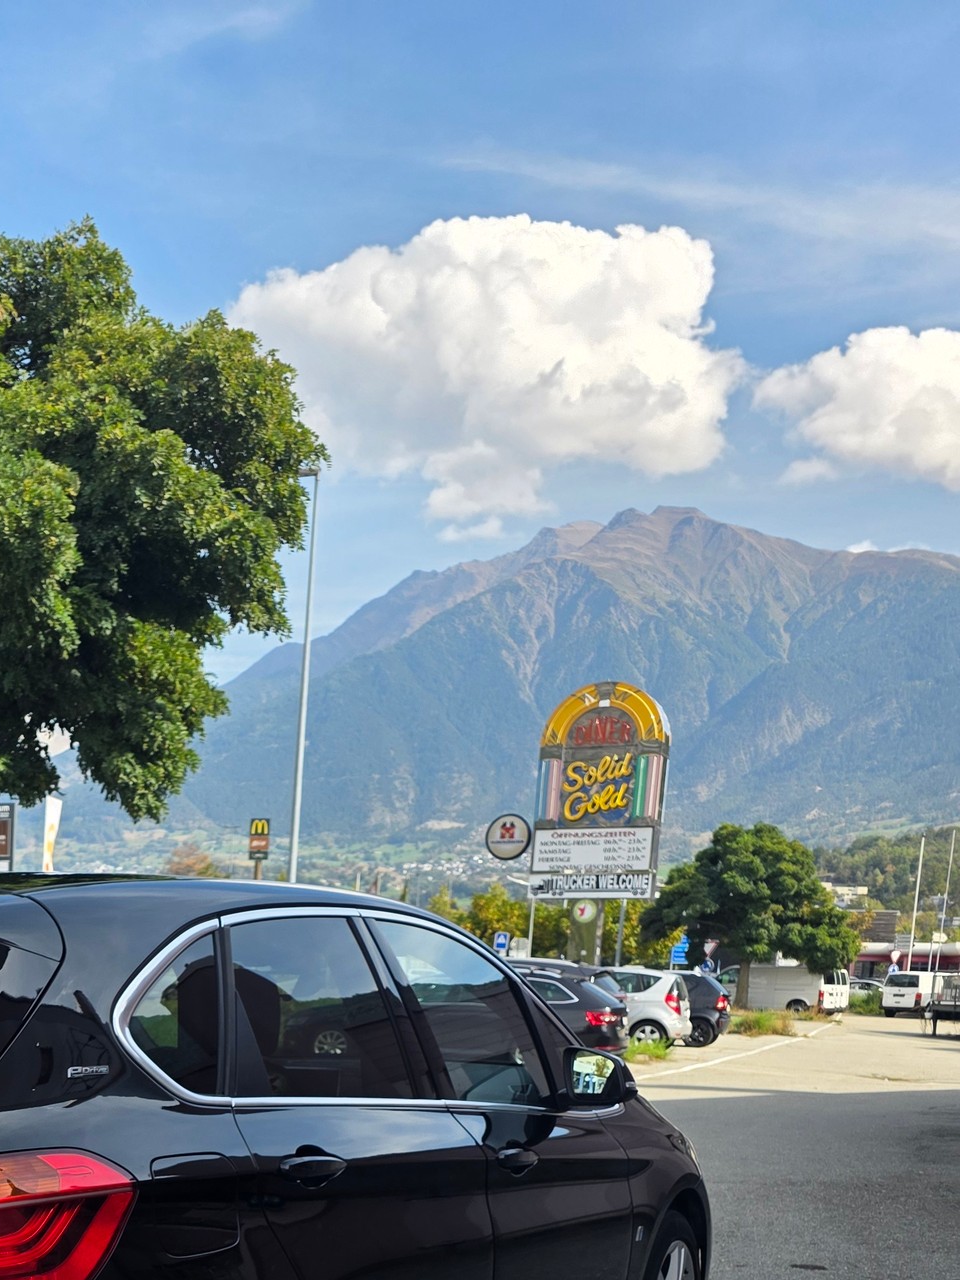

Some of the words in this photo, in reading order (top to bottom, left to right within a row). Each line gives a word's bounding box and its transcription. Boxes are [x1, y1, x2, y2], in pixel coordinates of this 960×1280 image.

[574, 716, 632, 745] DINER
[562, 752, 632, 792] Solid
[563, 783, 628, 821] Gold
[550, 873, 597, 890] TRUCKER
[598, 873, 649, 890] WELCOME
